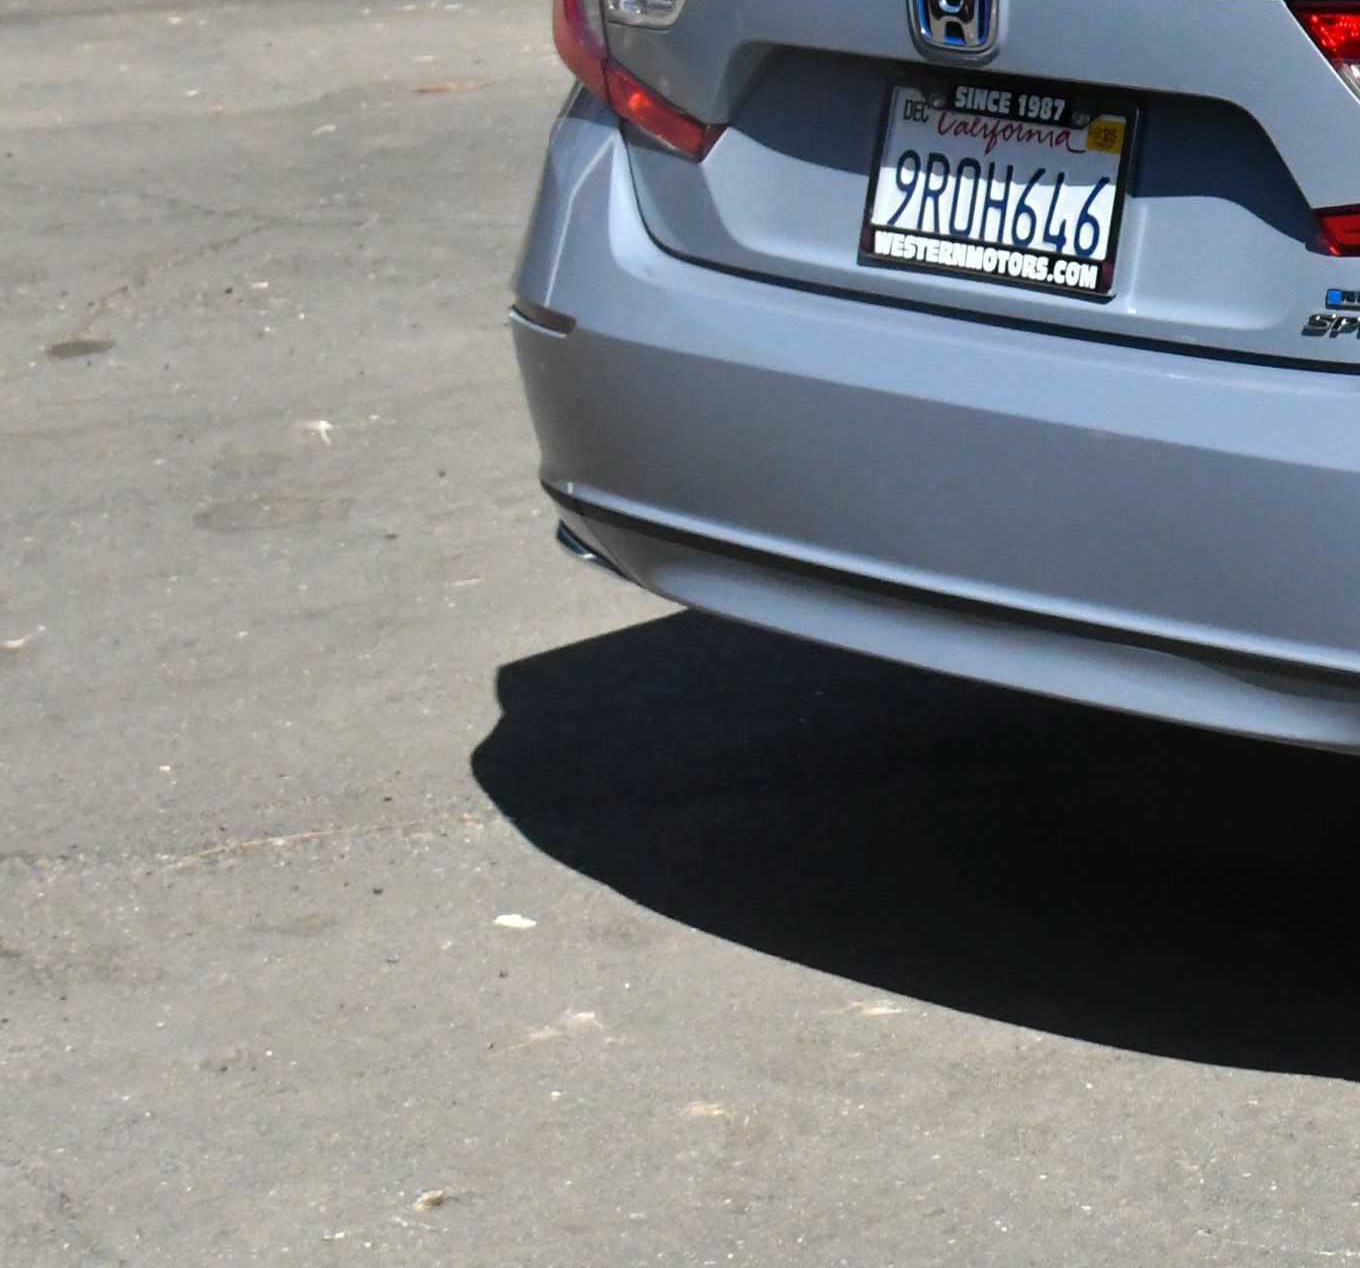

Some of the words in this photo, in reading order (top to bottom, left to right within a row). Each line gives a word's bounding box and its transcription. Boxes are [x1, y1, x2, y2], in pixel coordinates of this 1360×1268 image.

[903, 98, 930, 122] DEC
[954, 85, 1011, 114] SINCE
[1017, 93, 1067, 120] 1987
[936, 109, 1088, 155] California
[873, 229, 1099, 290] WESTERNMOTORS.COM
